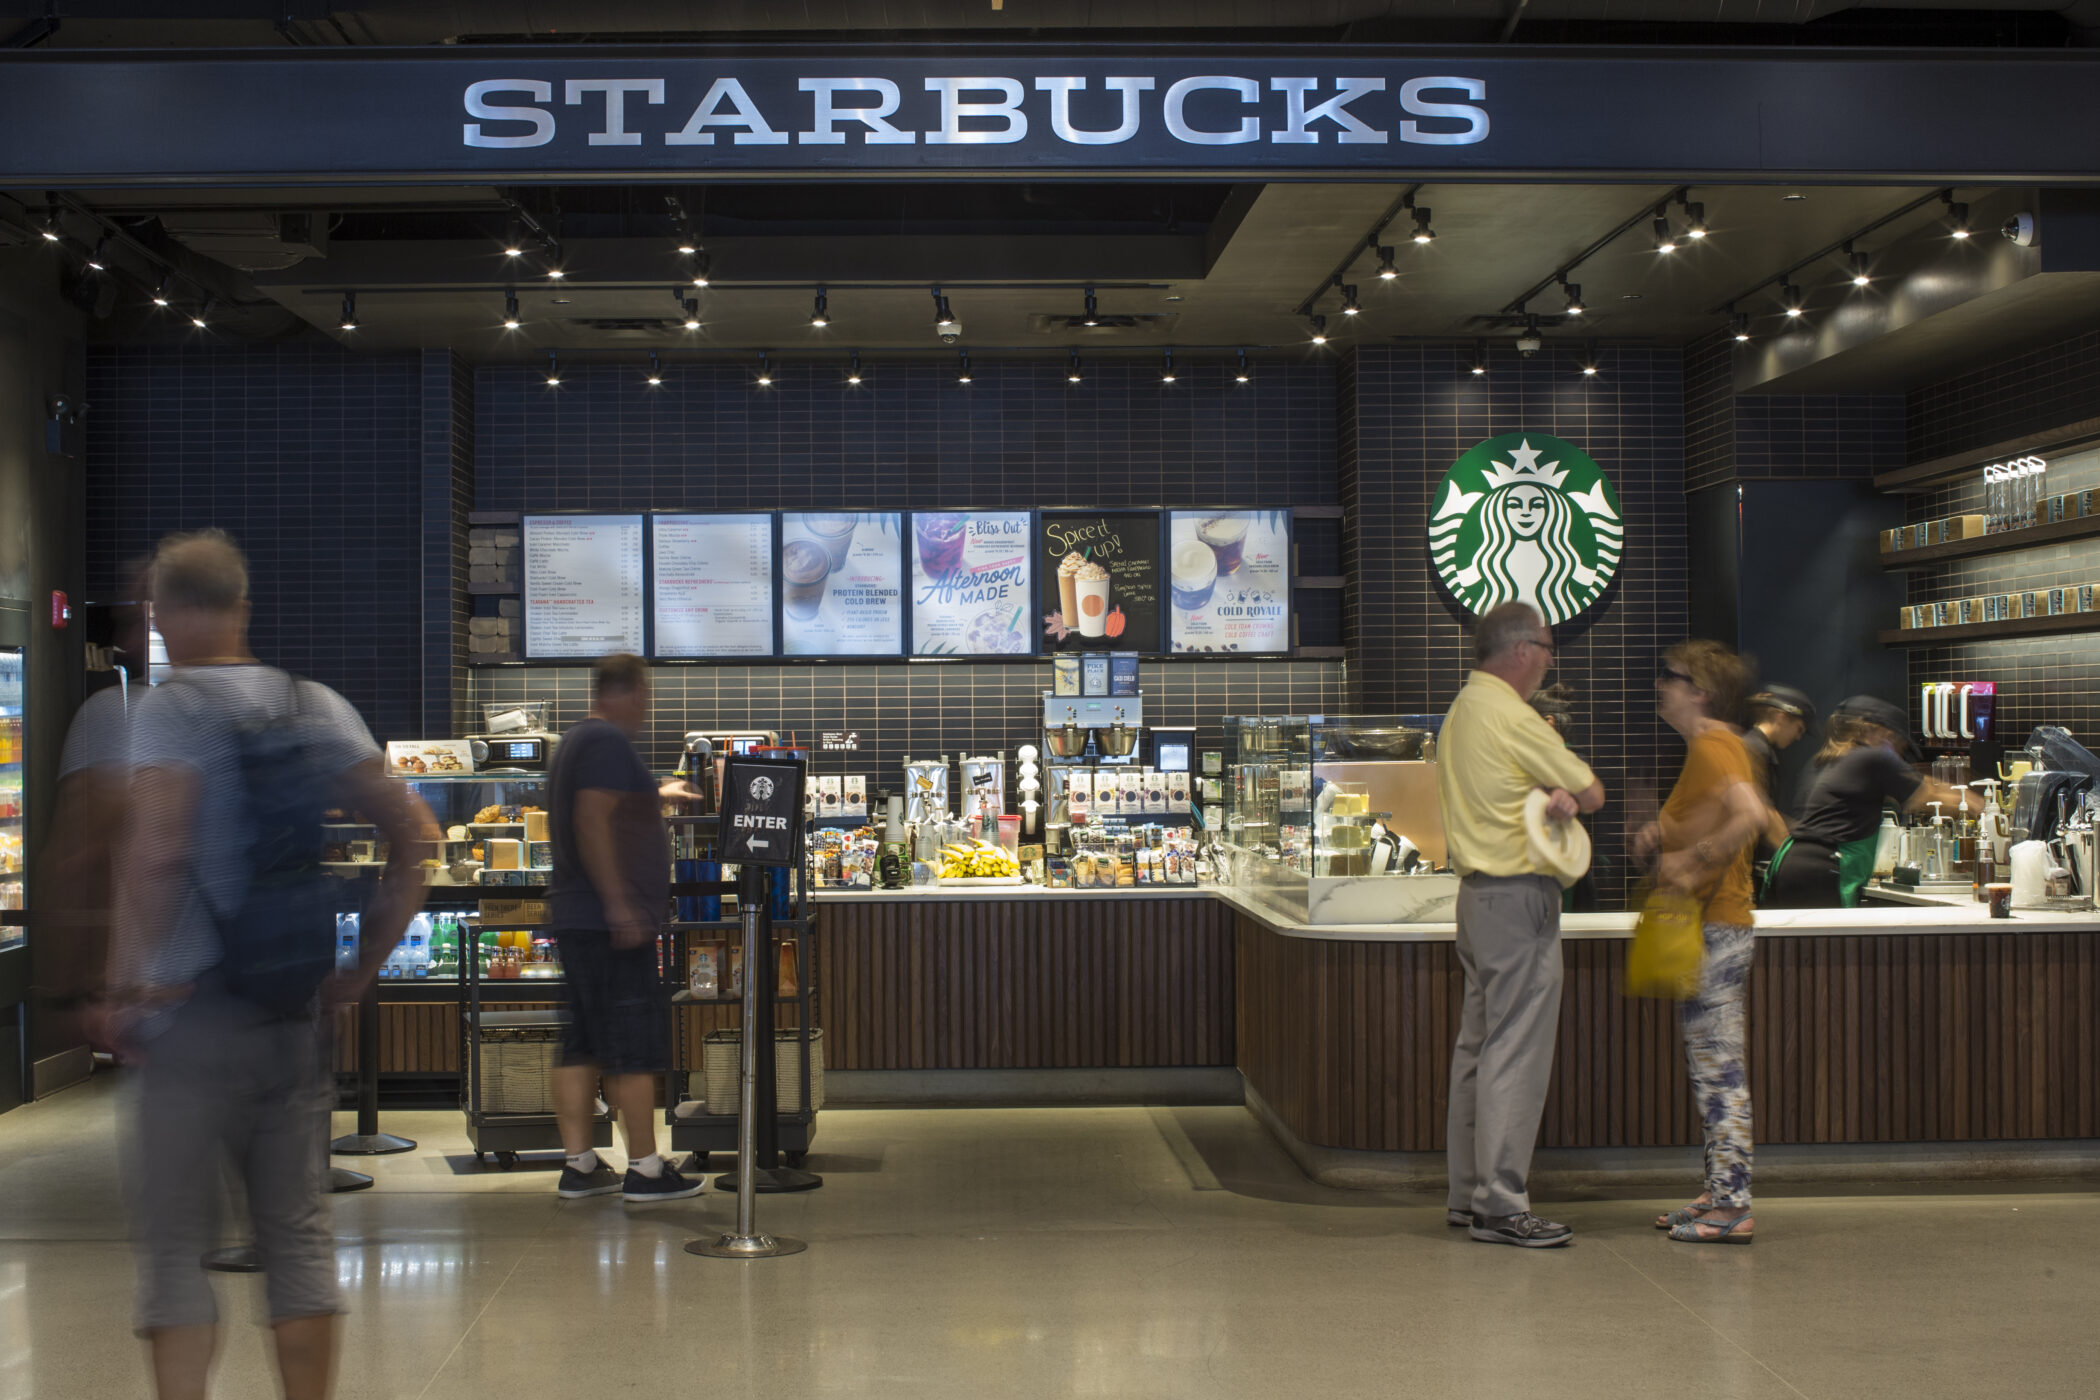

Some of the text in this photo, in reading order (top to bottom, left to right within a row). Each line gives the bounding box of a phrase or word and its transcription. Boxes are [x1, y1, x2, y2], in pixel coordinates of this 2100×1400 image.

[463, 76, 1490, 149] STARBUCKS
[976, 521, 1022, 536] Bliss Out
[1046, 518, 1110, 556] Spice it
[1094, 534, 1123, 558] up!
[917, 566, 1025, 605] Afternoon
[960, 584, 1009, 605] MADE
[1217, 606, 1281, 617] COLD ROYALE
[734, 815, 787, 830] ENTER
